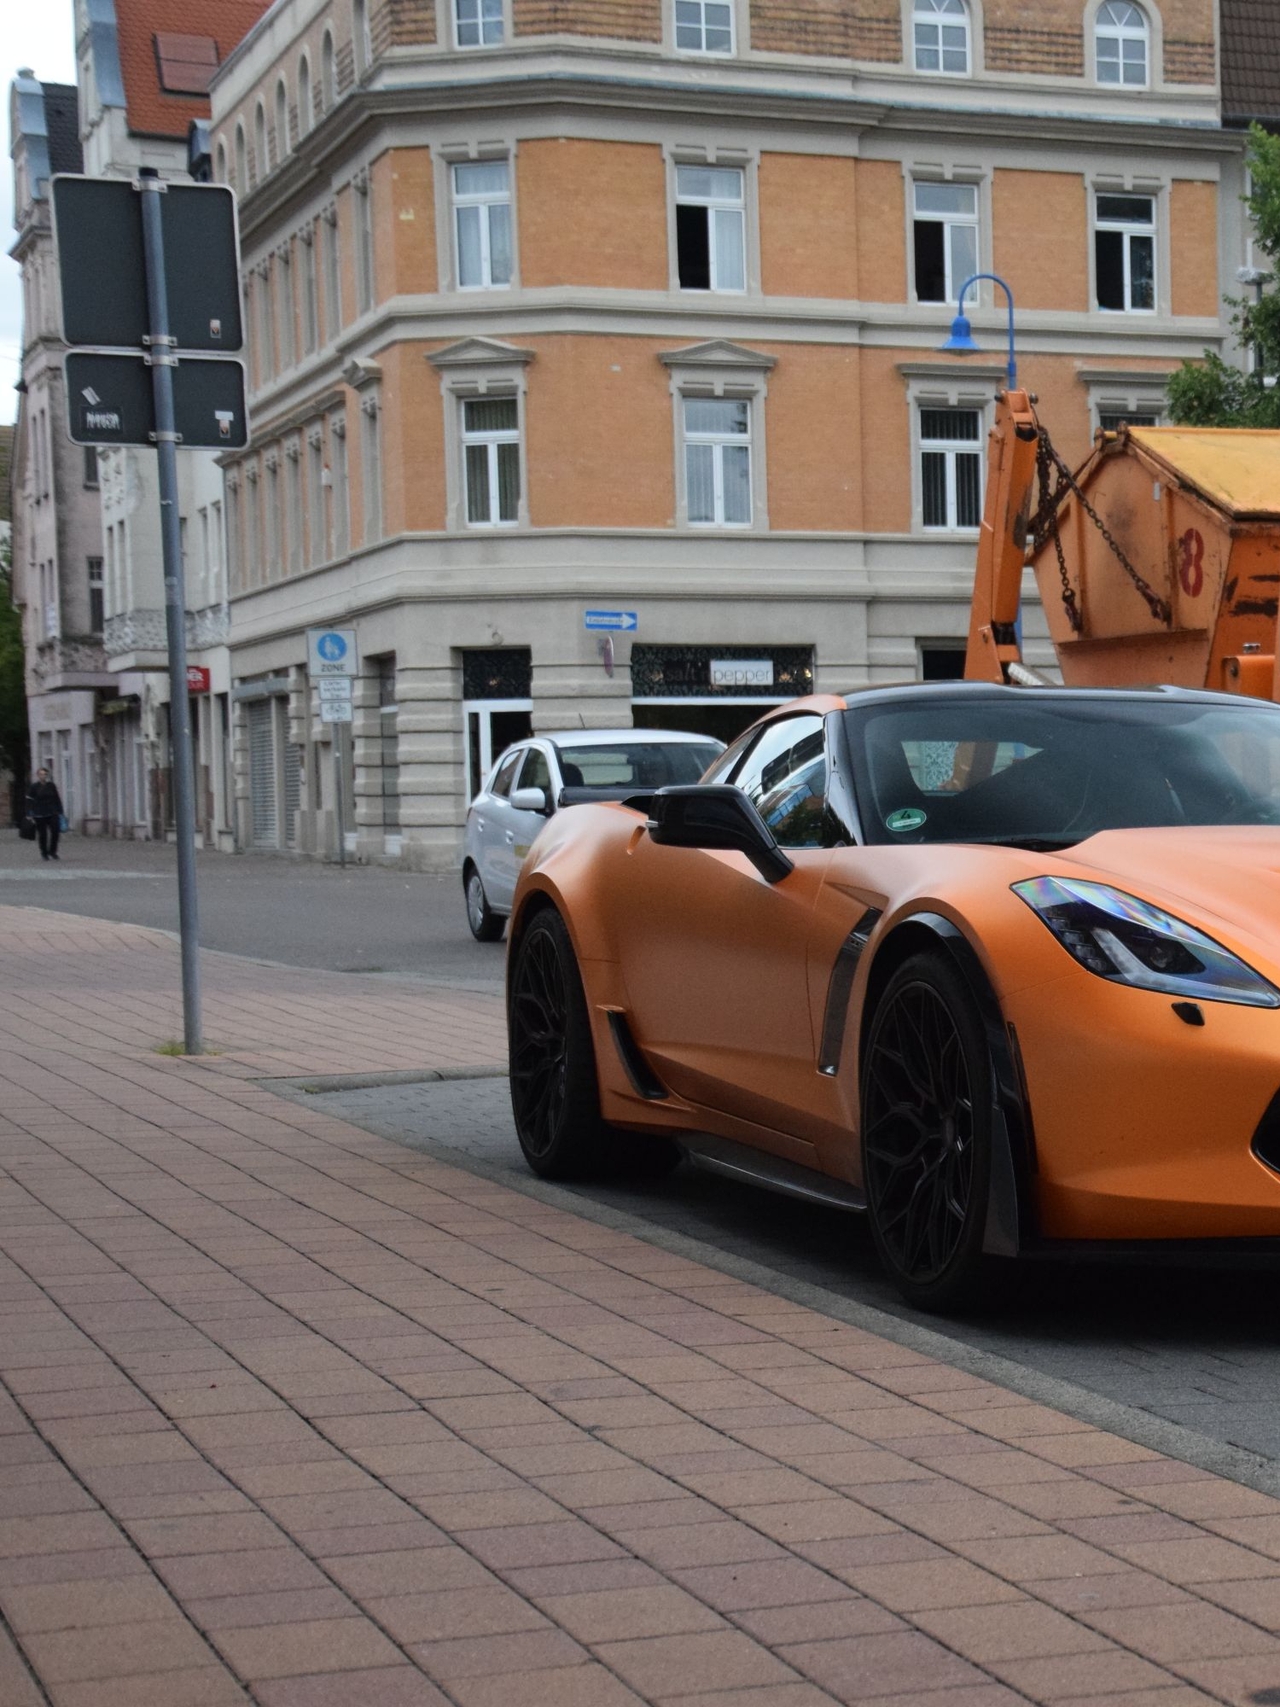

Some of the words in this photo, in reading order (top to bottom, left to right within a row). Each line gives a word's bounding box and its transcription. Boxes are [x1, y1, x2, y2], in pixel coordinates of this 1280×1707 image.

[1181, 528, 1204, 598] 8
[321, 664, 347, 672] ZONE
[713, 669, 771, 685] pepper
[901, 810, 911, 820] 4
